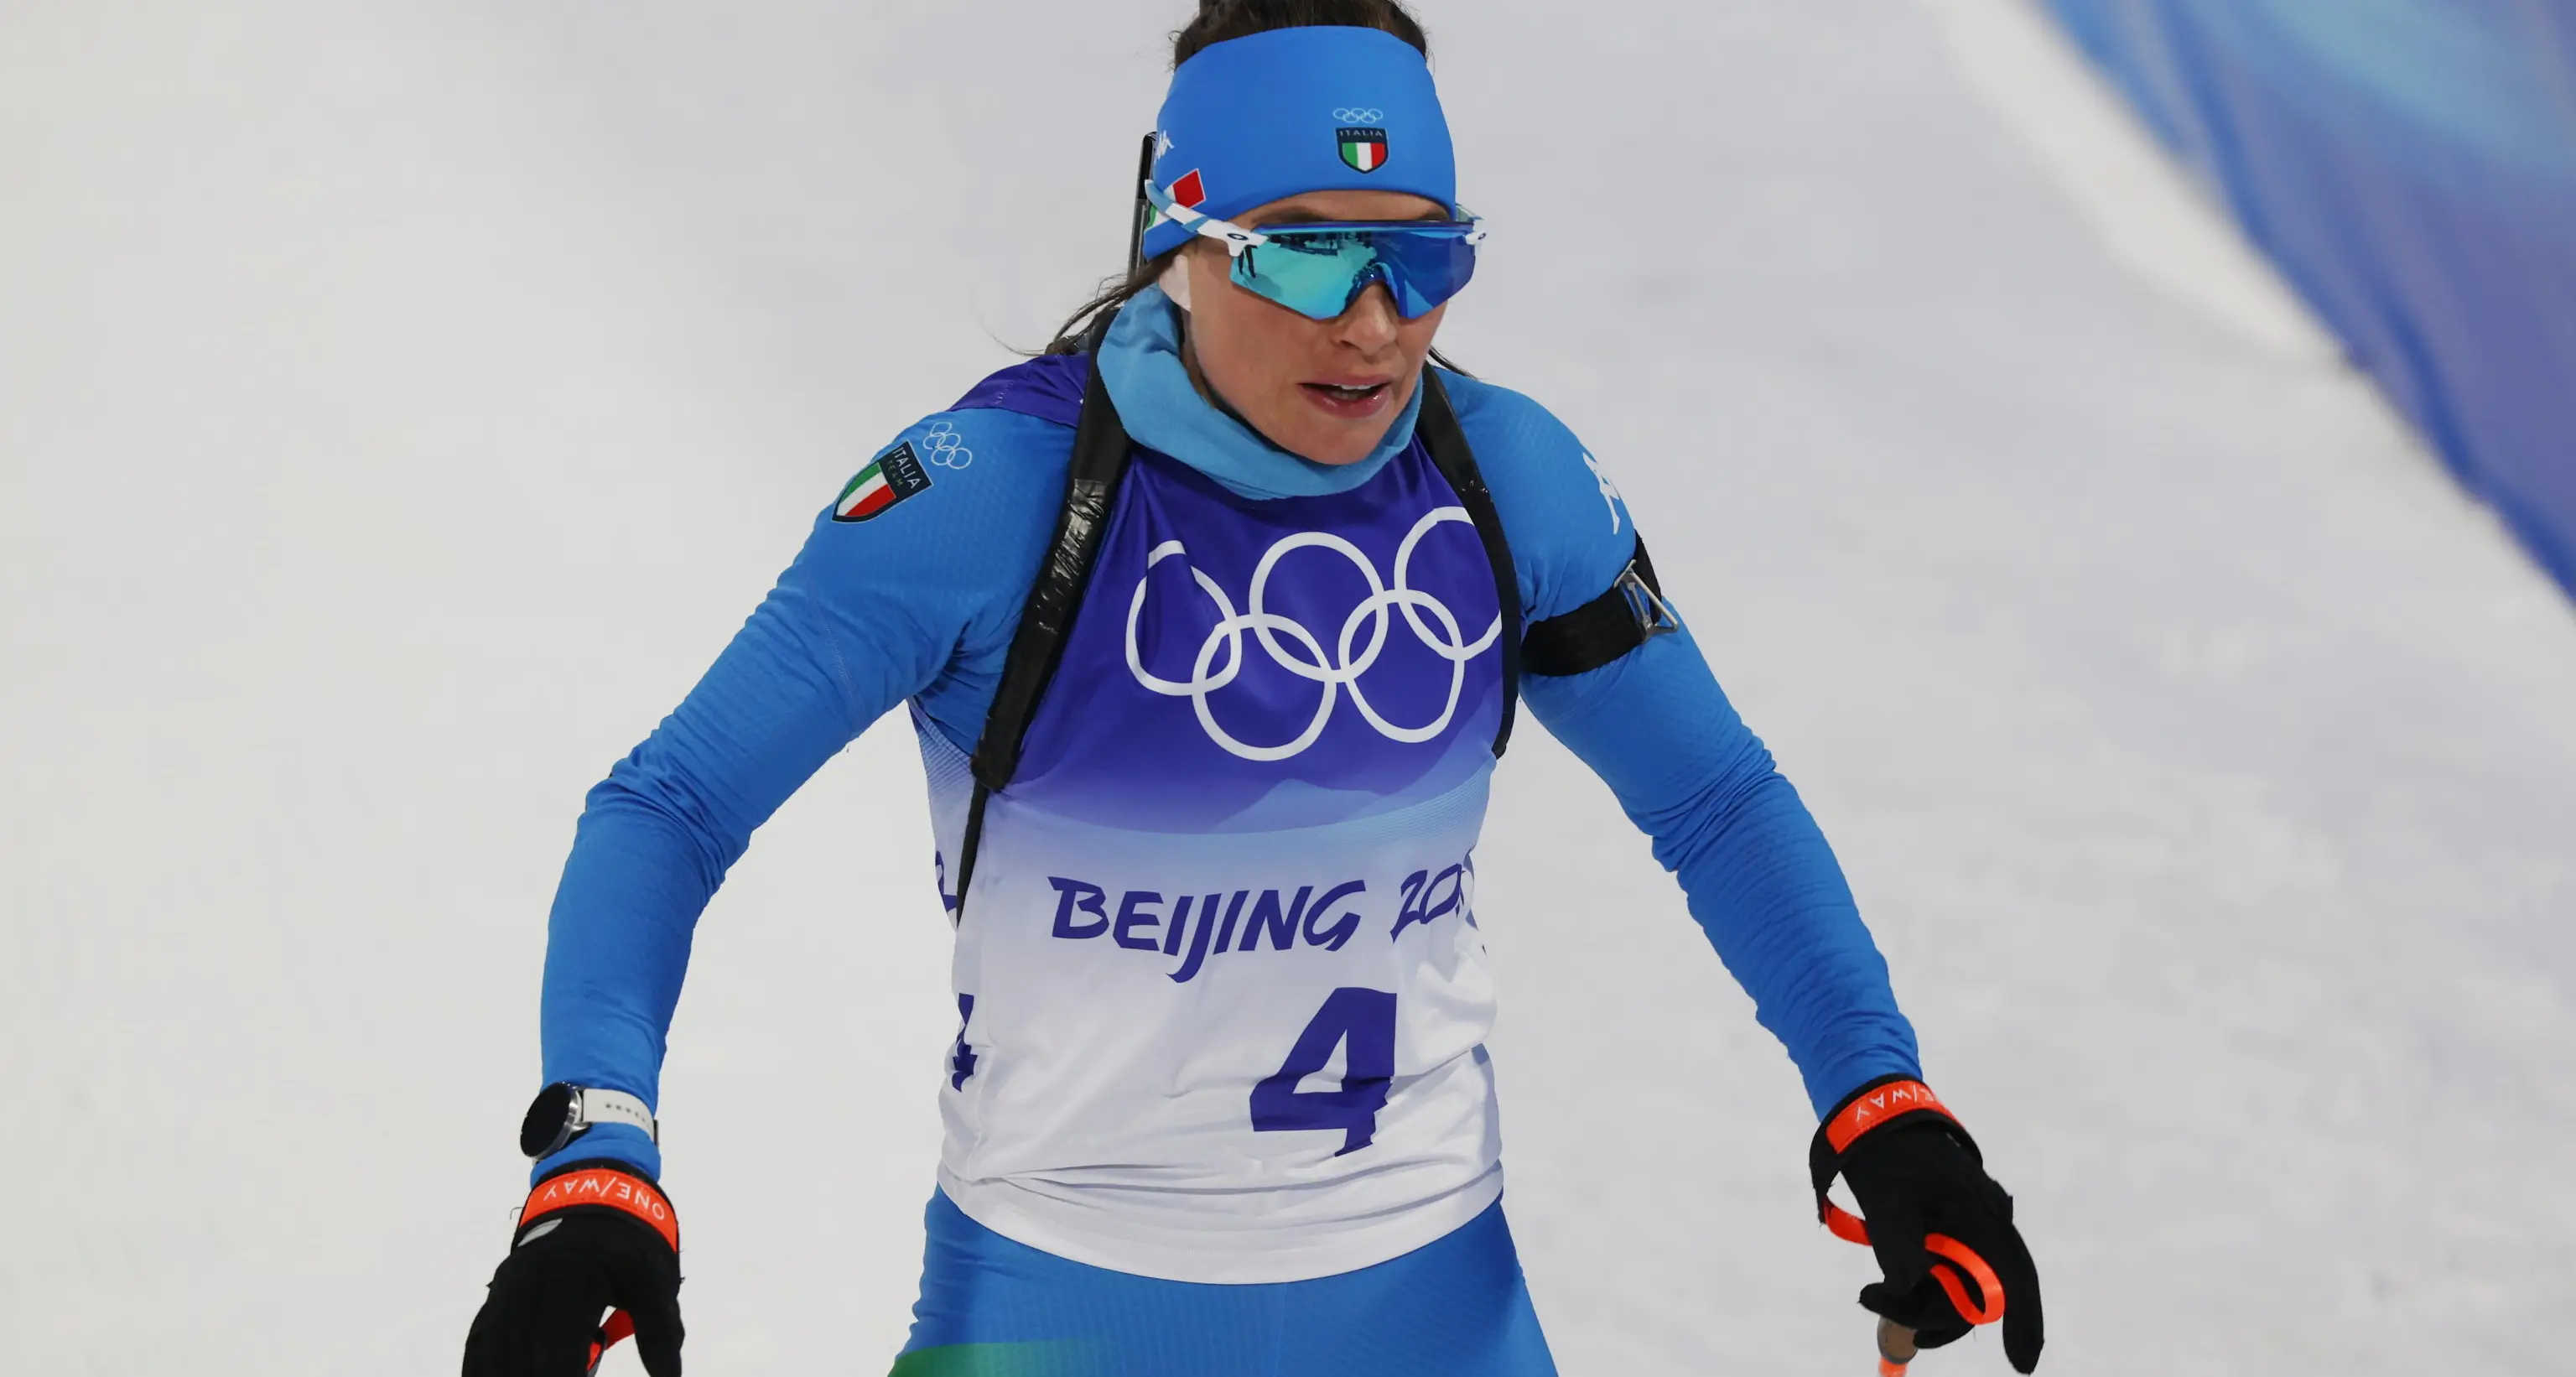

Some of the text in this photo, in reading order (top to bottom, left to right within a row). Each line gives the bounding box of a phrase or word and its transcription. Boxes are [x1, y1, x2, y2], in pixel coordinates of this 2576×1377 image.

[1339, 129, 1383, 138] ITALIA
[886, 460, 904, 487] TEAM
[891, 446, 922, 490] ITALIA
[1046, 876, 1369, 984] BEIJING
[1389, 863, 1466, 944] 20
[1249, 986, 1398, 1158] 4
[543, 1176, 666, 1221] ONE/WAY
